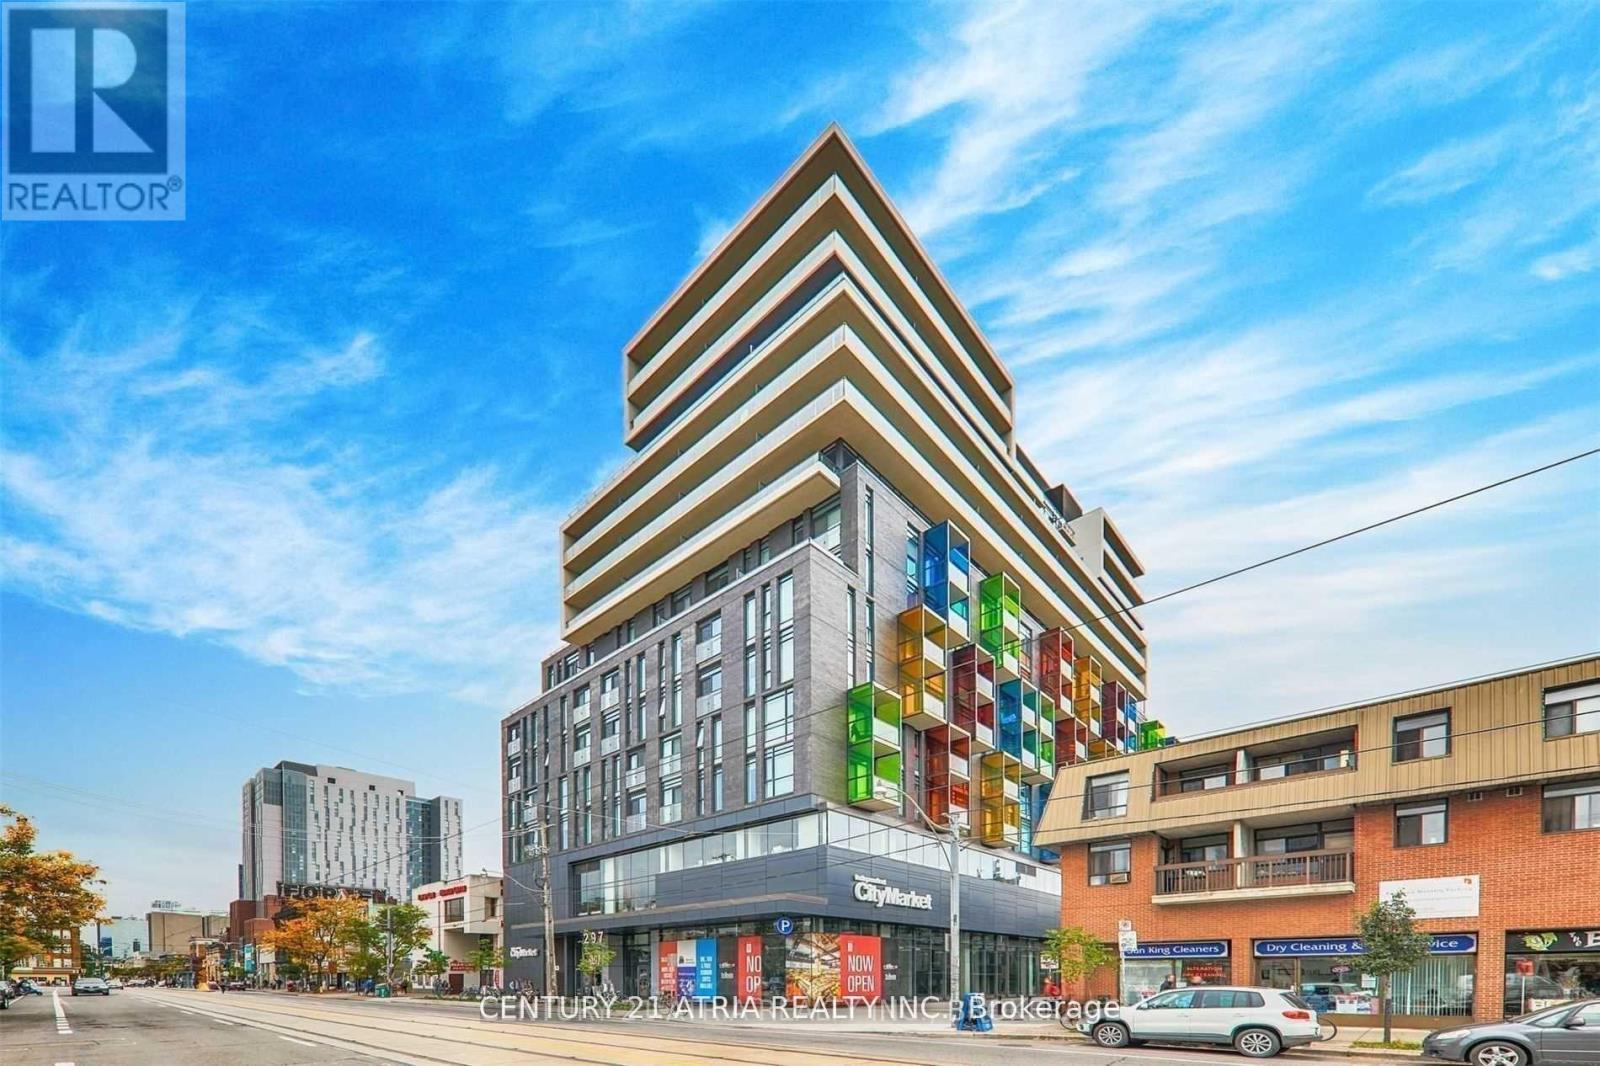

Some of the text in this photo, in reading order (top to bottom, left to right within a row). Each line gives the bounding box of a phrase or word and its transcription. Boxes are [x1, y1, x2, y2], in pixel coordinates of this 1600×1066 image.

[854, 881, 933, 910] CityMarket
[583, 931, 604, 944] 297
[1148, 945, 1170, 955] King
[1172, 944, 1220, 953] Cleaners
[1266, 943, 1287, 953] Dry
[1290, 942, 1347, 952] Cleaning
[1351, 941, 1363, 950] &
[847, 955, 874, 972] NOW
[847, 976, 875, 992] OPEN
